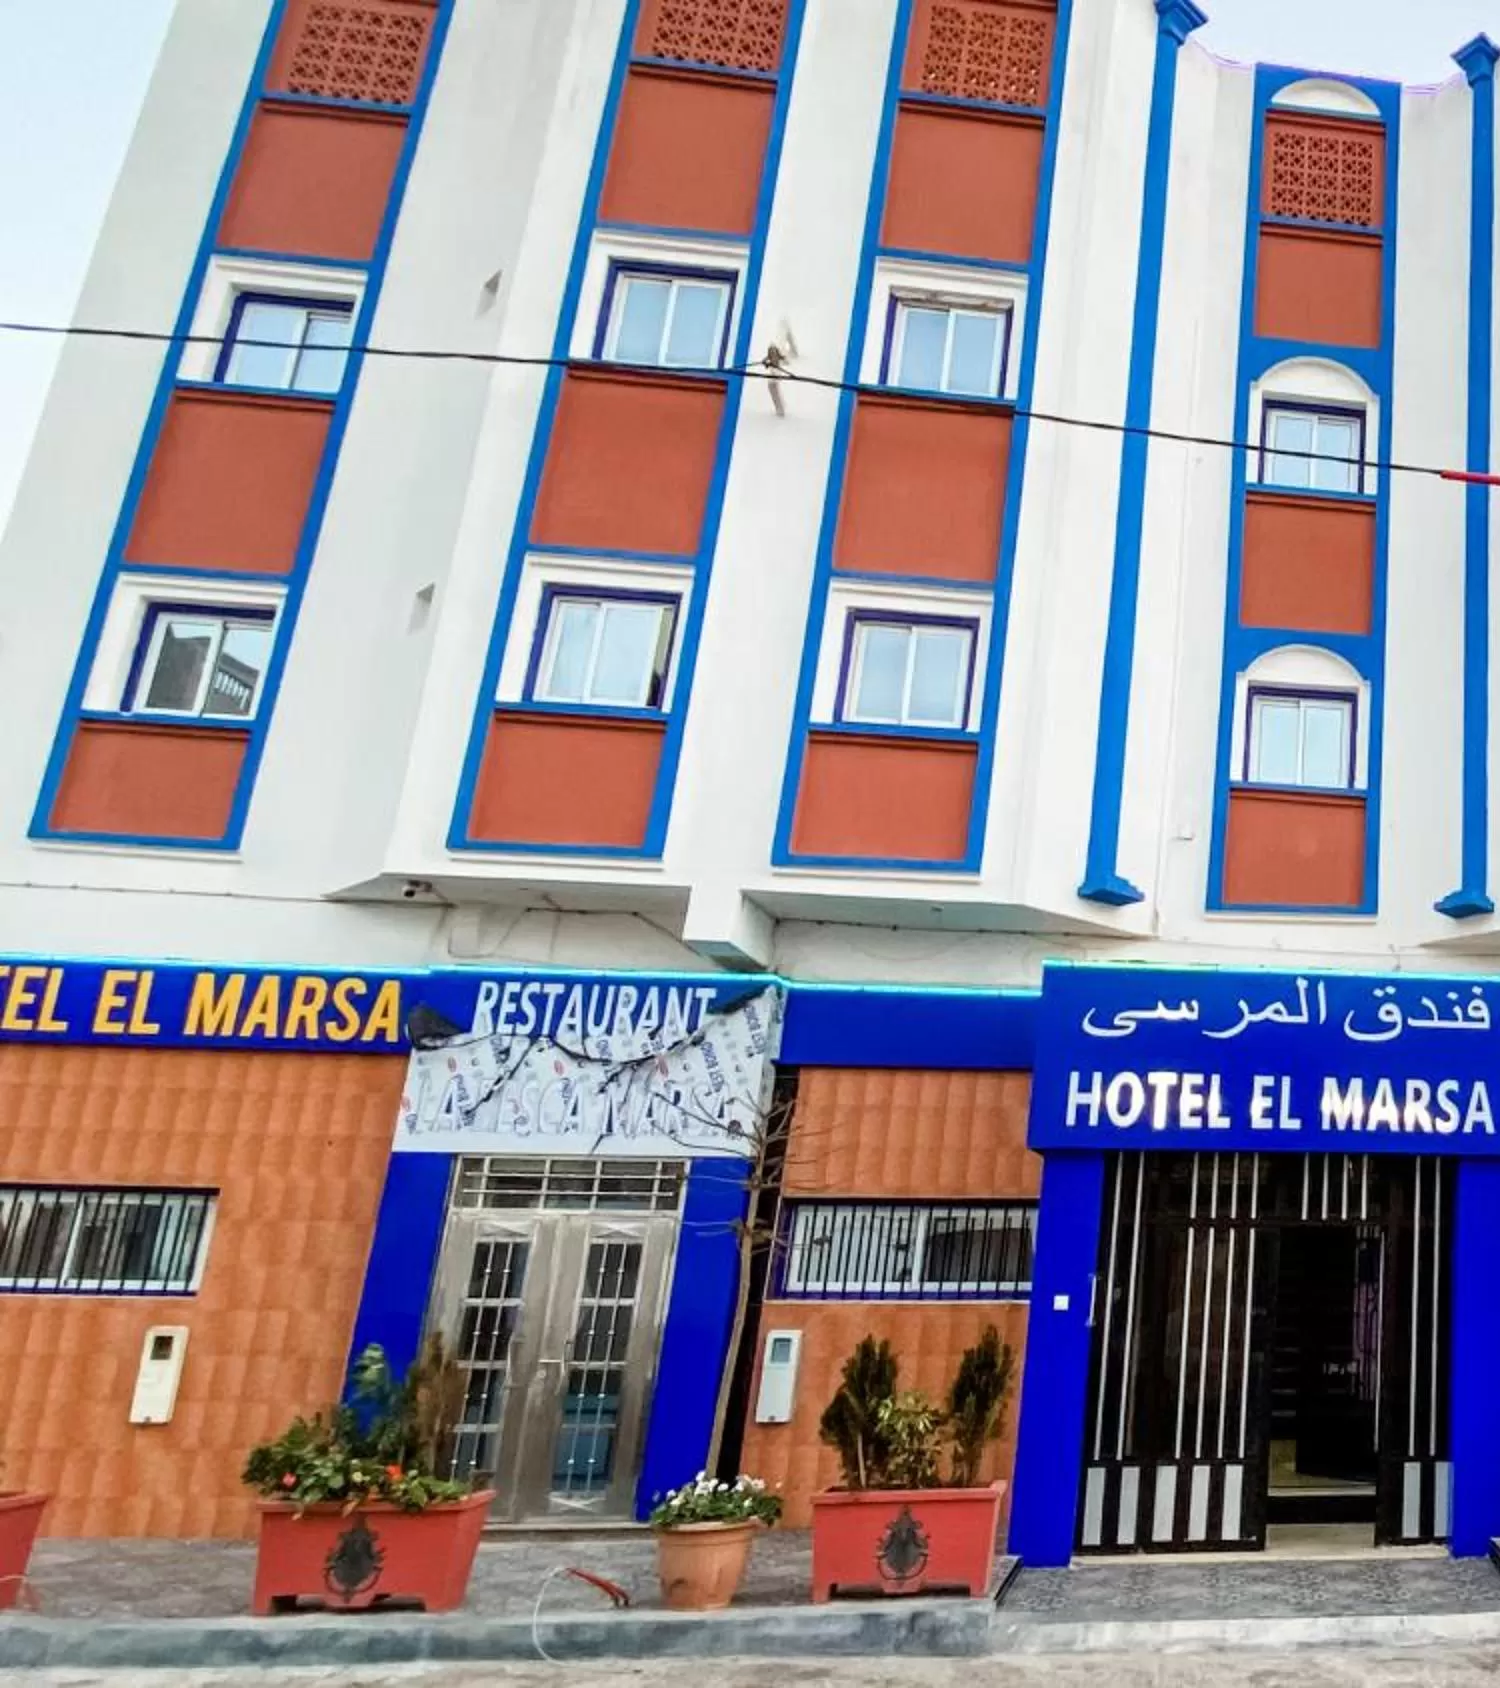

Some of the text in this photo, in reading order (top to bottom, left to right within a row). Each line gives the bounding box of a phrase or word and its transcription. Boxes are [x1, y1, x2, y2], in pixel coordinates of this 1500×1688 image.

[92, 969, 160, 1035] EL
[183, 972, 400, 1043] MARSA
[470, 980, 718, 1038] RESTAURANT
[1082, 976, 1491, 1041] فندق المرسى
[1065, 1071, 1496, 1135] HOTEL EL MARSA
